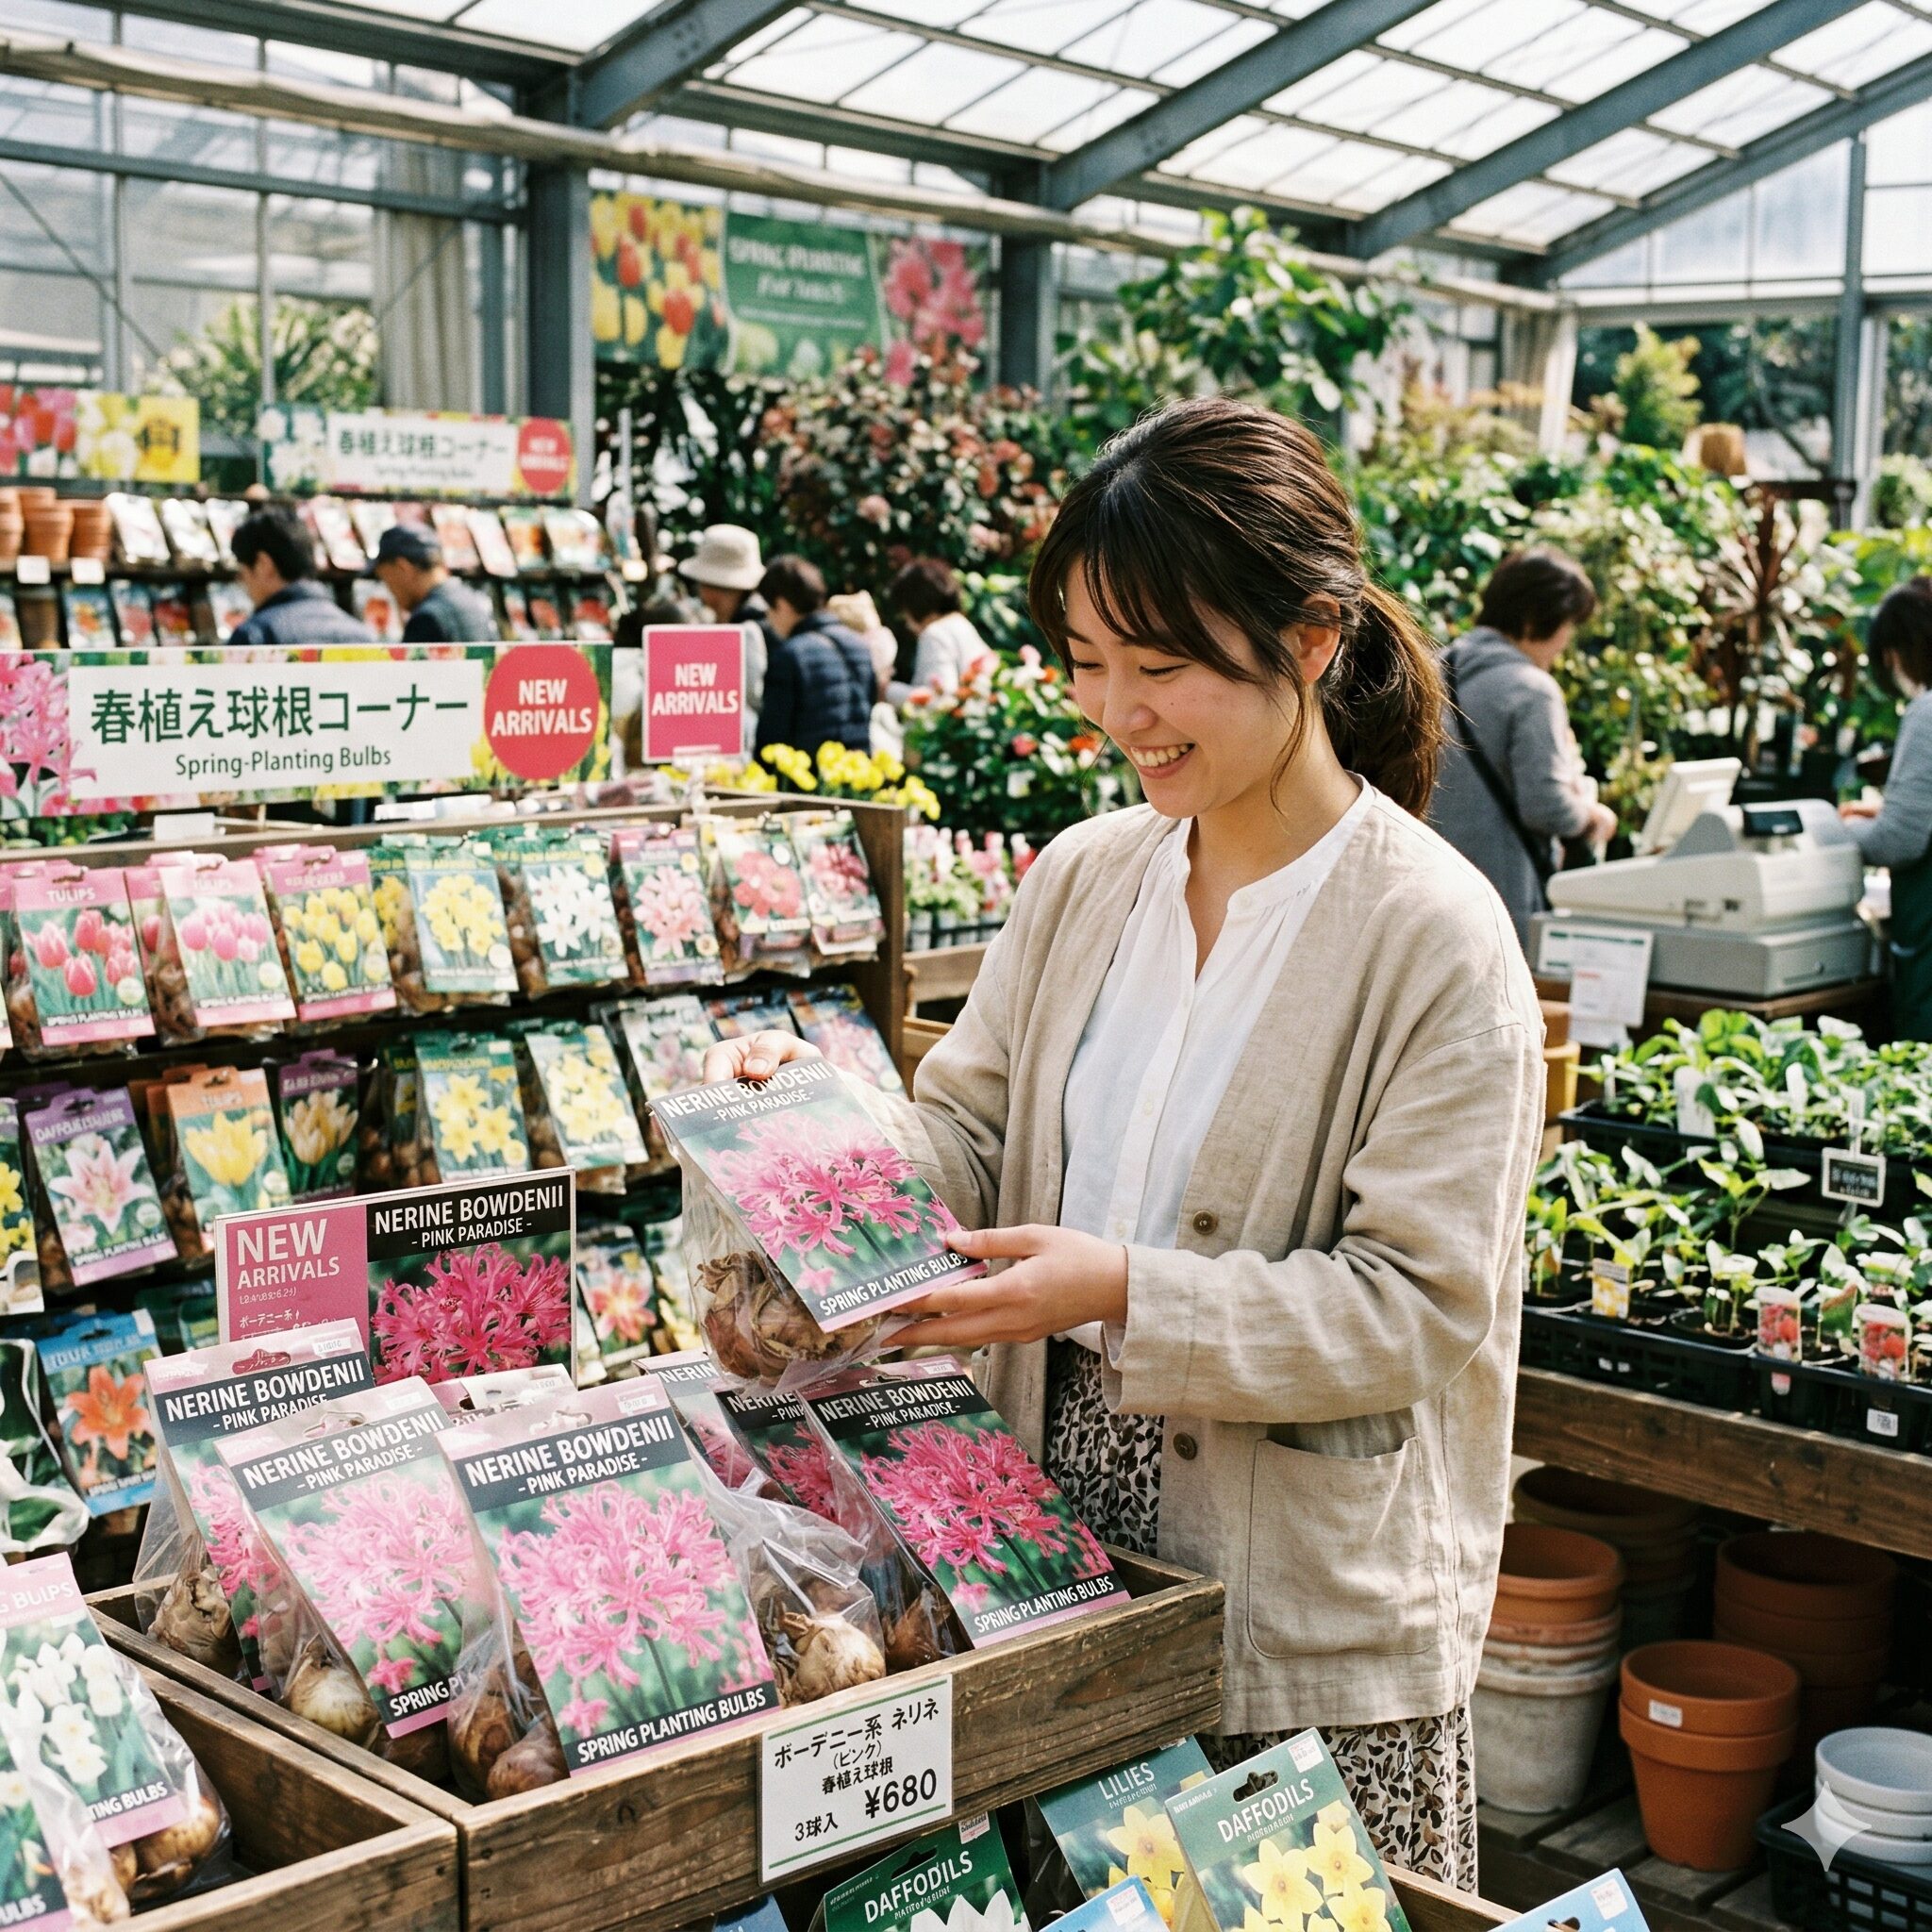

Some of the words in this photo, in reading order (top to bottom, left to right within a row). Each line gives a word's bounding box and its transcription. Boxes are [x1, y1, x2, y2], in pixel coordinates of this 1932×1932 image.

[518, 679, 567, 706] NEW
[675, 663, 717, 688] NEW
[92, 683, 468, 744] 春植え球根コーナー
[491, 708, 593, 737] ARRIVALS
[652, 691, 739, 716] ARRIVALS
[175, 749, 333, 780] Spring-Planting
[341, 746, 391, 767] Bulbs
[46, 887, 95, 903] TULIPS
[659, 1083, 739, 1119] NERINE
[737, 1061, 833, 1100] BOWDENII
[375, 1200, 454, 1235] NERINE
[459, 1184, 563, 1221] BOWDENII
[237, 1218, 328, 1266] NEW
[237, 1257, 341, 1291] ARRIVALS
[819, 1285, 870, 1317] SPRING
[870, 1262, 931, 1295] PLANTING
[928, 1252, 969, 1275] BULBS
[165, 1383, 247, 1423] NERINE
[254, 1358, 365, 1403] BOWDENII
[660, 1360, 721, 1385] NERIN
[817, 1391, 890, 1423] NERINE
[885, 1379, 975, 1407] BOWDENII
[242, 1442, 327, 1490] NERINE
[331, 1409, 445, 1456] BOWDENII
[464, 1443, 558, 1488] NERINE
[557, 1415, 675, 1464] BOWDENII
[974, 1605, 1022, 1634] SPRING
[1019, 1587, 1078, 1619] PLANTING
[1076, 1575, 1115, 1601] BULBS
[390, 1681, 450, 1717] SPRING
[576, 1728, 638, 1764] SPRING
[638, 1703, 718, 1745] PLANTING
[717, 1687, 767, 1720] BULBS
[774, 1713, 883, 1770] ボーデニー系
[891, 1697, 940, 1730] ネリネ
[822, 1756, 893, 1795] 春植え球根
[864, 1768, 938, 1819] ¥680
[1097, 1761, 1156, 1801] LILIES
[89, 1796, 123, 1822] TING
[121, 1780, 169, 1811] BULBS
[1216, 1777, 1315, 1843] DAFFODILS
[794, 1811, 839, 1842] 3球入
[863, 1849, 974, 1924] DAFFODILS
[0, 1893, 46, 1925] ULBS
